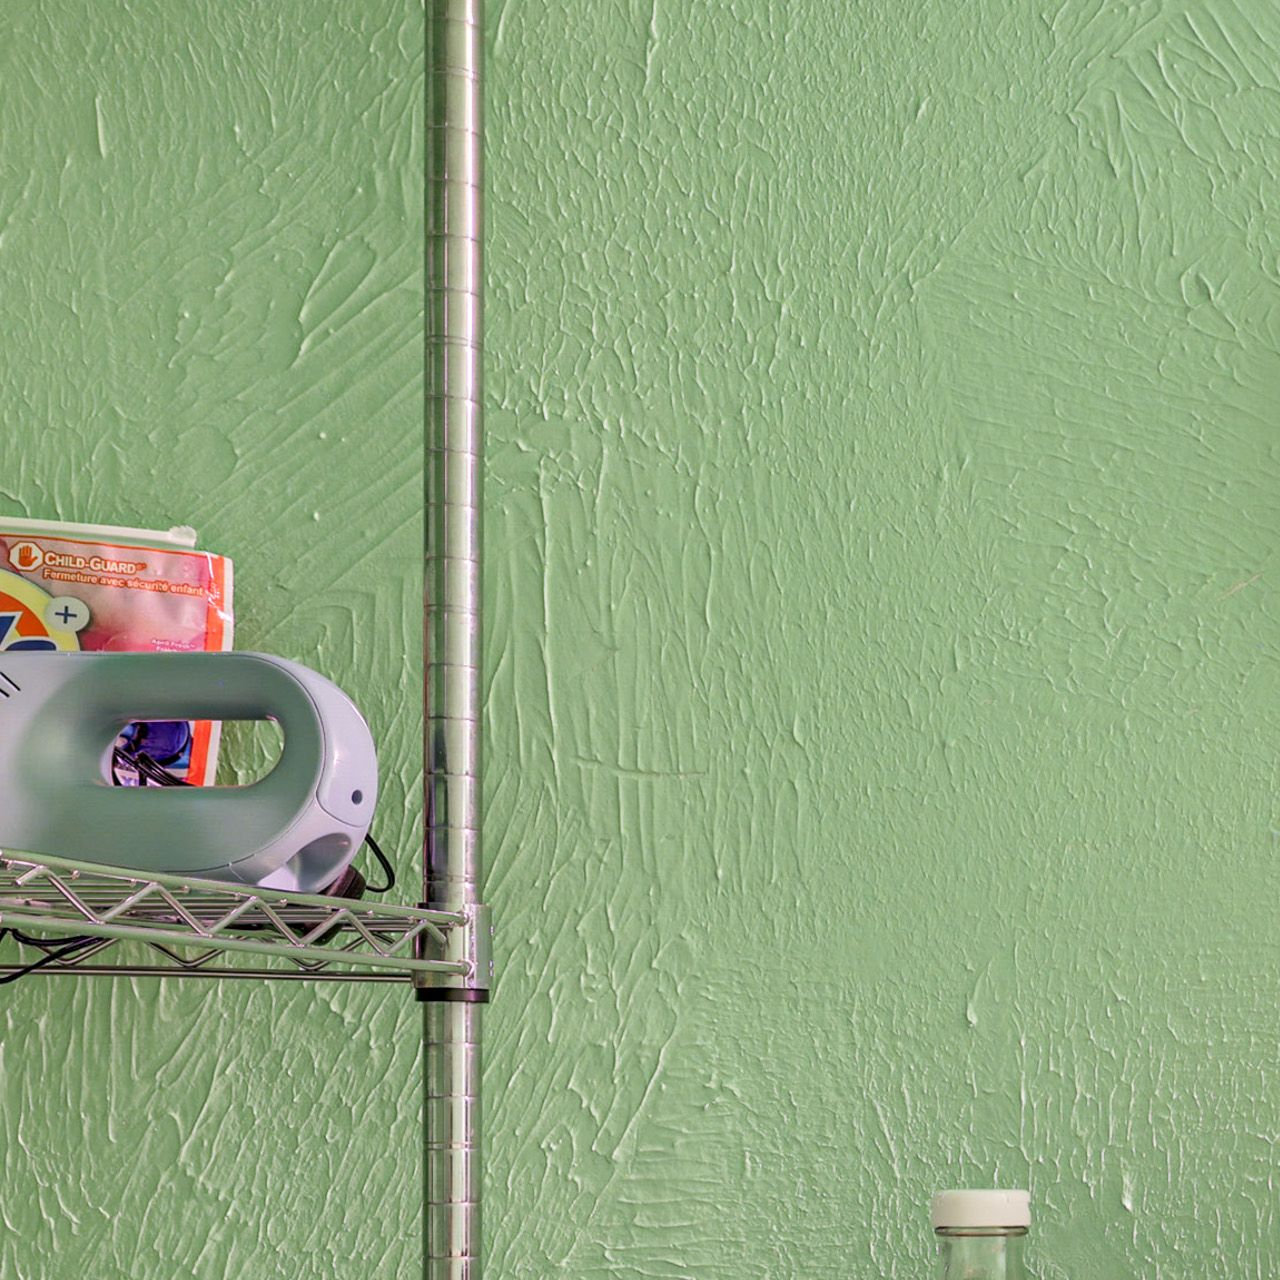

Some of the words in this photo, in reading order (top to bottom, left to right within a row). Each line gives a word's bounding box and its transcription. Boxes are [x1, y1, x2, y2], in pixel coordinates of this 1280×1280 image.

[44, 552, 136, 574] CHILD-GUARD
[42, 569, 98, 583] Fermeture
[100, 576, 125, 587] avec
[127, 578, 168, 593] sécurité
[170, 583, 204, 597] enfant
